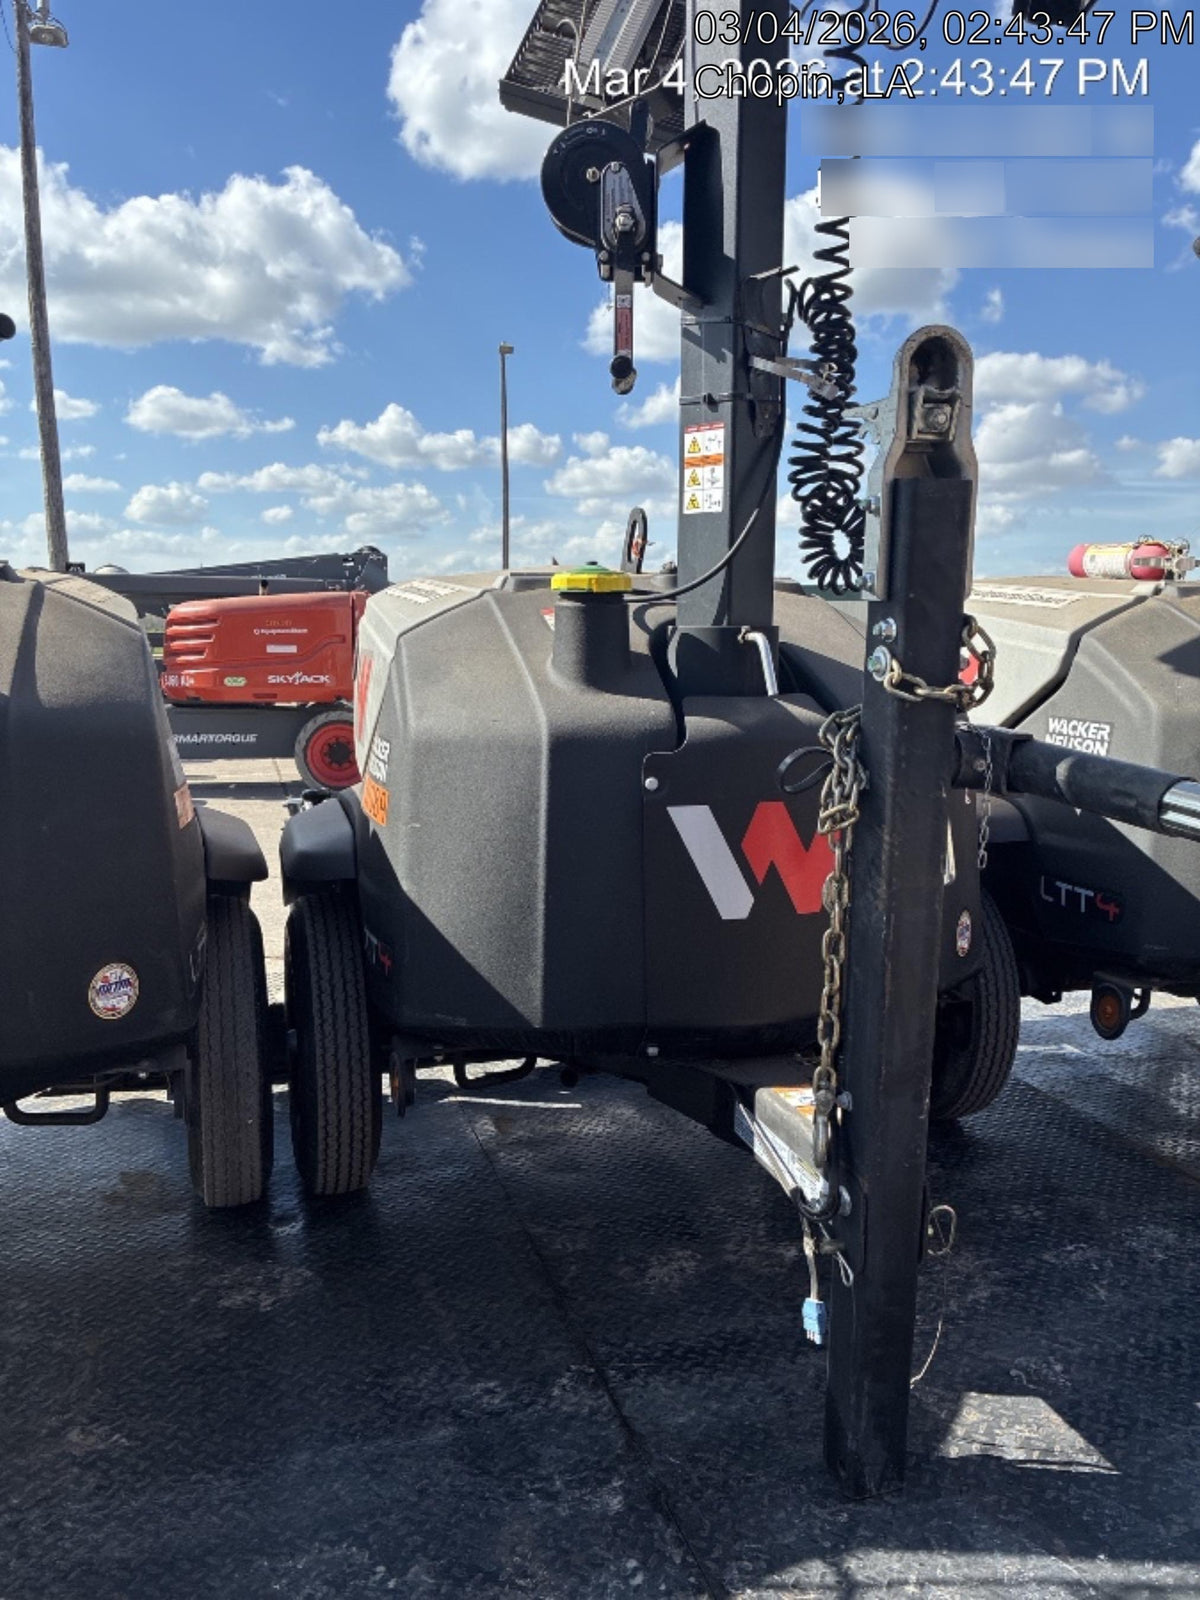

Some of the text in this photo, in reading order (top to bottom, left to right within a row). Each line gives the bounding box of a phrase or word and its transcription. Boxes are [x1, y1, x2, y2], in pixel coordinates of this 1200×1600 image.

[267, 672, 331, 685] SKYJACK
[1048, 717, 1111, 741] WACKER
[1040, 875, 1120, 921] LTT4
